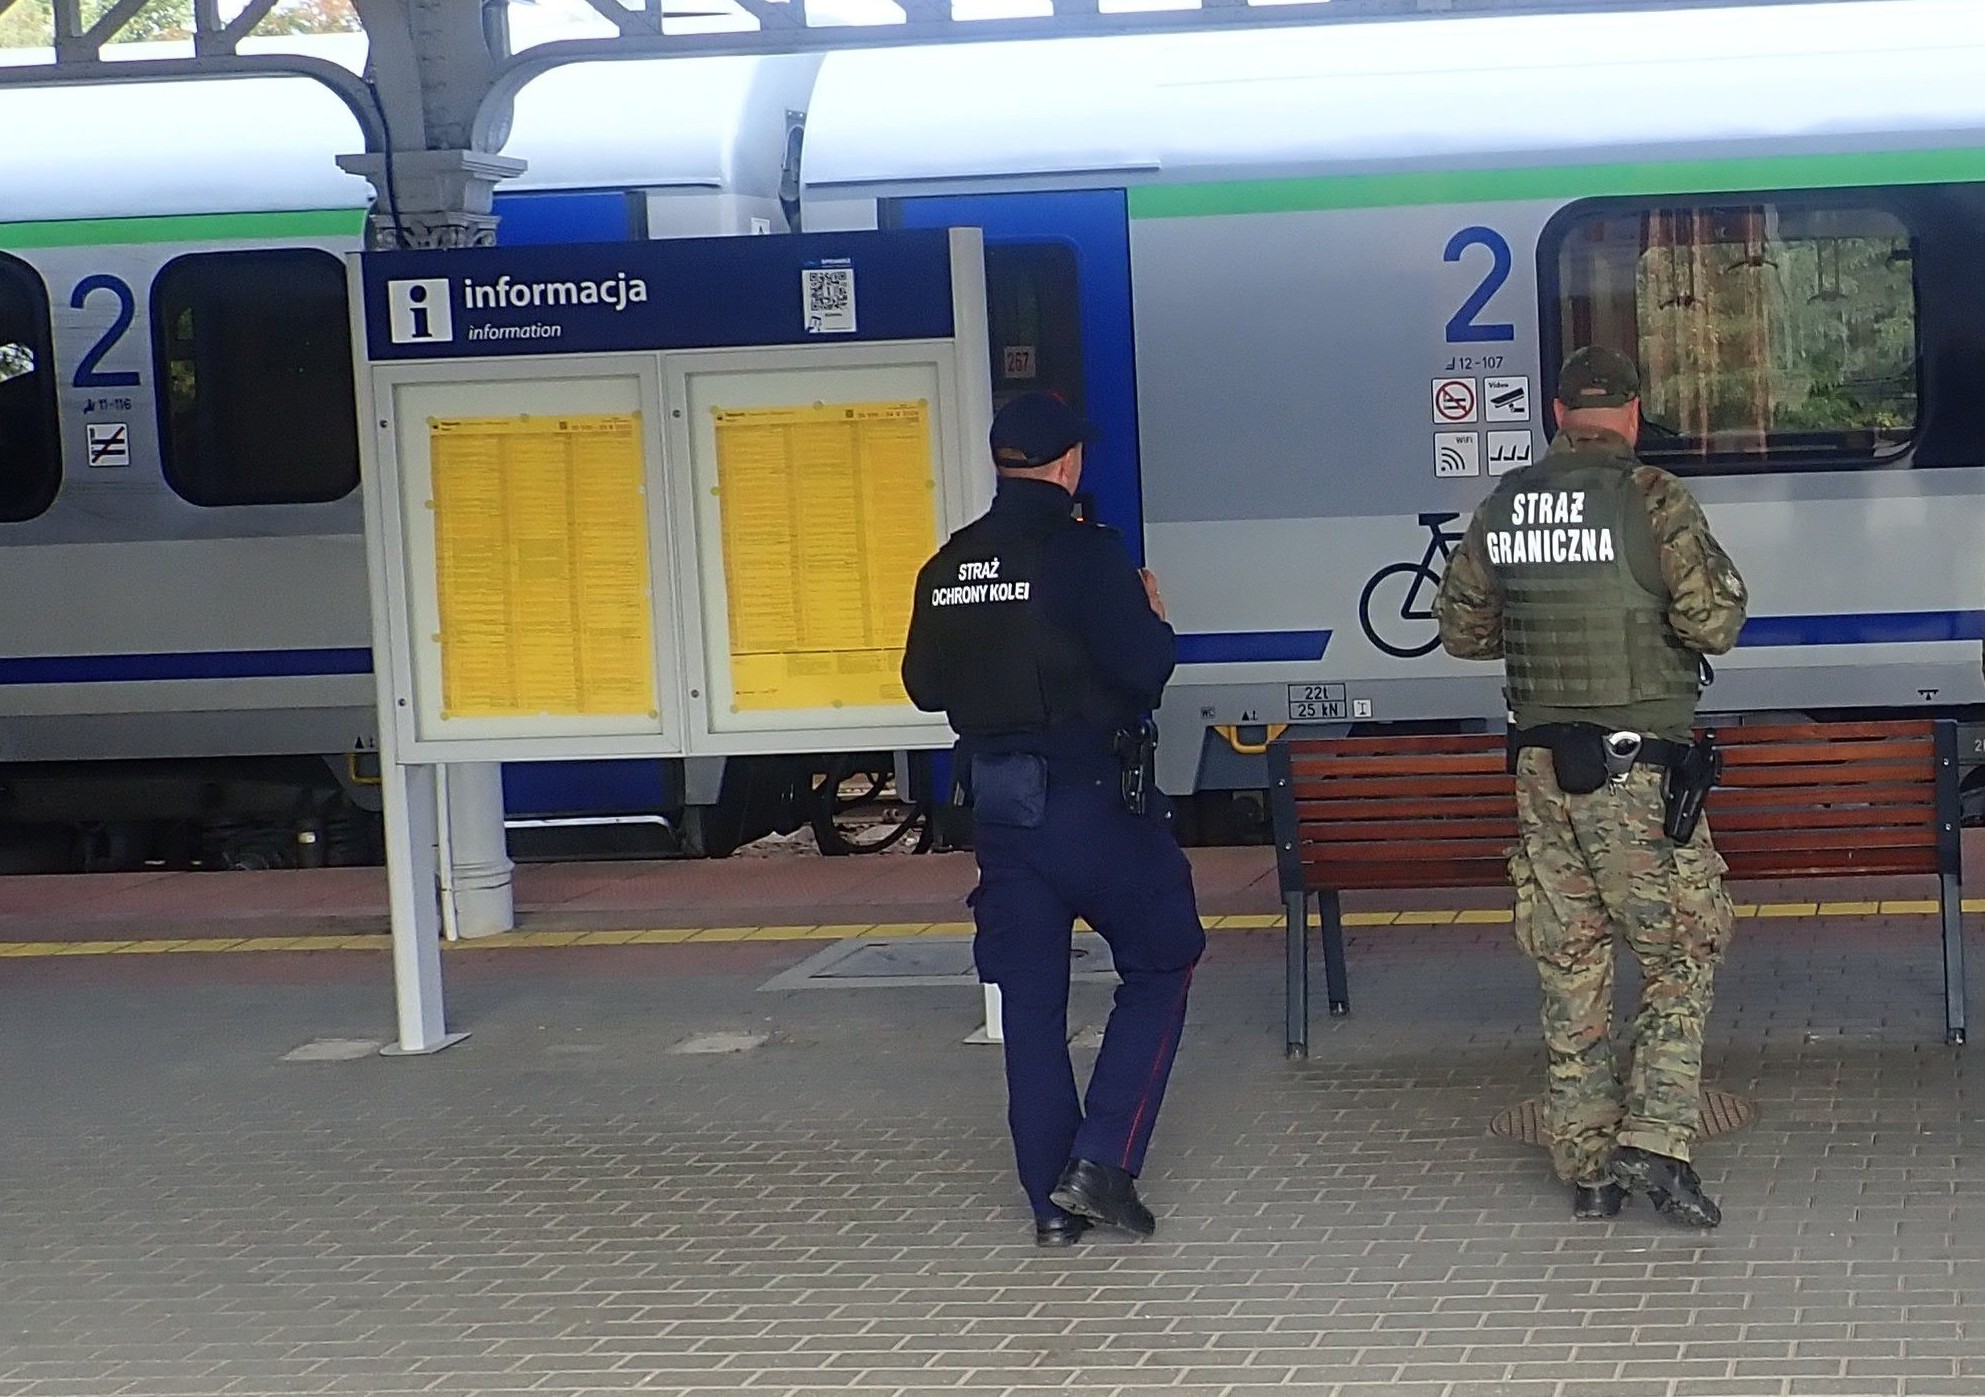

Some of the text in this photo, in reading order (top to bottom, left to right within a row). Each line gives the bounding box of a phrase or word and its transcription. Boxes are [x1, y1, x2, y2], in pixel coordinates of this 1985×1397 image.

[464, 272, 648, 311] informacja
[1443, 226, 1515, 343] 2
[70, 274, 142, 388] 2
[468, 322, 562, 341] information
[1007, 351, 1029, 372] 267
[1486, 528, 1615, 565] GRANICZNA
[958, 557, 1000, 581] STRAŻ
[931, 581, 1030, 607] OCHRONY KOLEI
[1298, 703, 1338, 718] 25 kN
